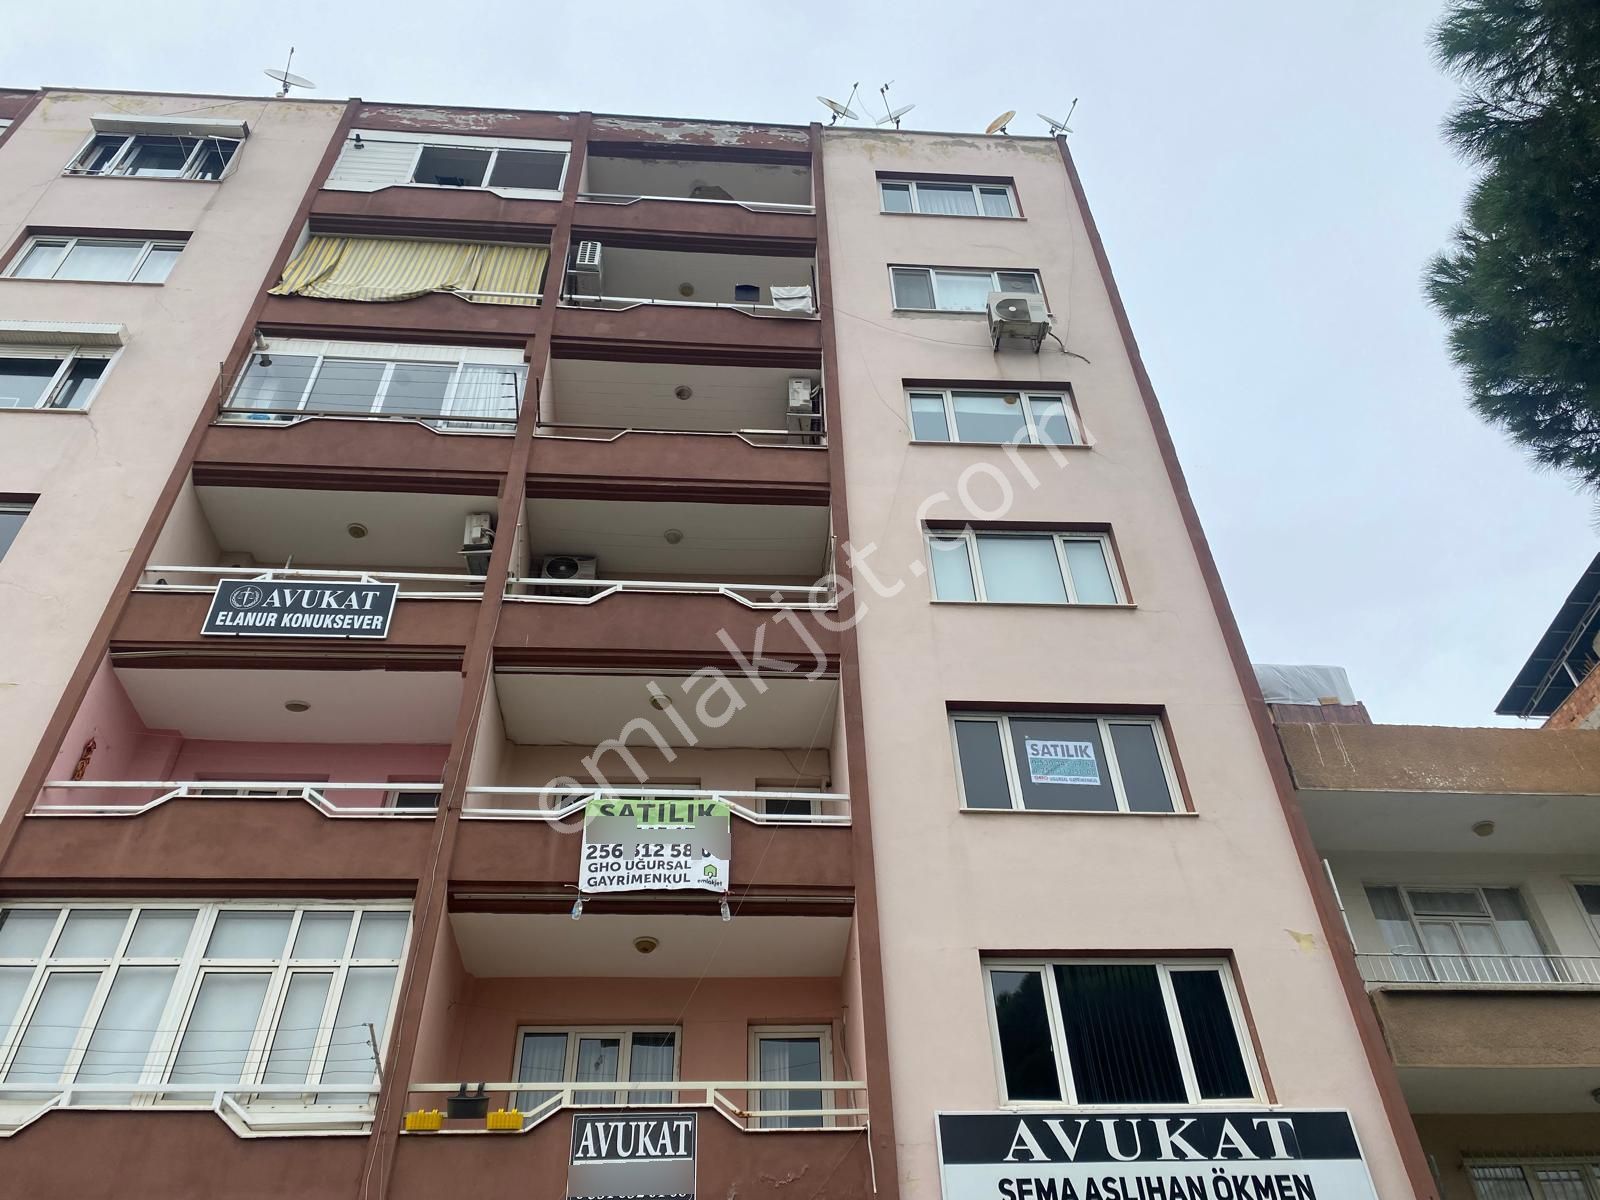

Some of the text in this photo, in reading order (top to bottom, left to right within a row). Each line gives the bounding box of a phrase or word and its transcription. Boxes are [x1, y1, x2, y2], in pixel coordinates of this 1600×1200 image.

[261, 588, 380, 610] AVUKAT
[215, 611, 383, 630] ELANUR KONUKSEVER
[1030, 743, 1091, 758] SATILIK
[585, 843, 623, 860] 256
[588, 858, 692, 873] GHO UĞURSAL
[587, 872, 691, 887] GAYRİMENKUL
[575, 1120, 692, 1158] AVUKAT
[1002, 1117, 1295, 1162] AVUKAT
[1085, 1175, 1208, 1200] ASLIHAN
[1212, 1167, 1317, 1200] ÖKMEN
